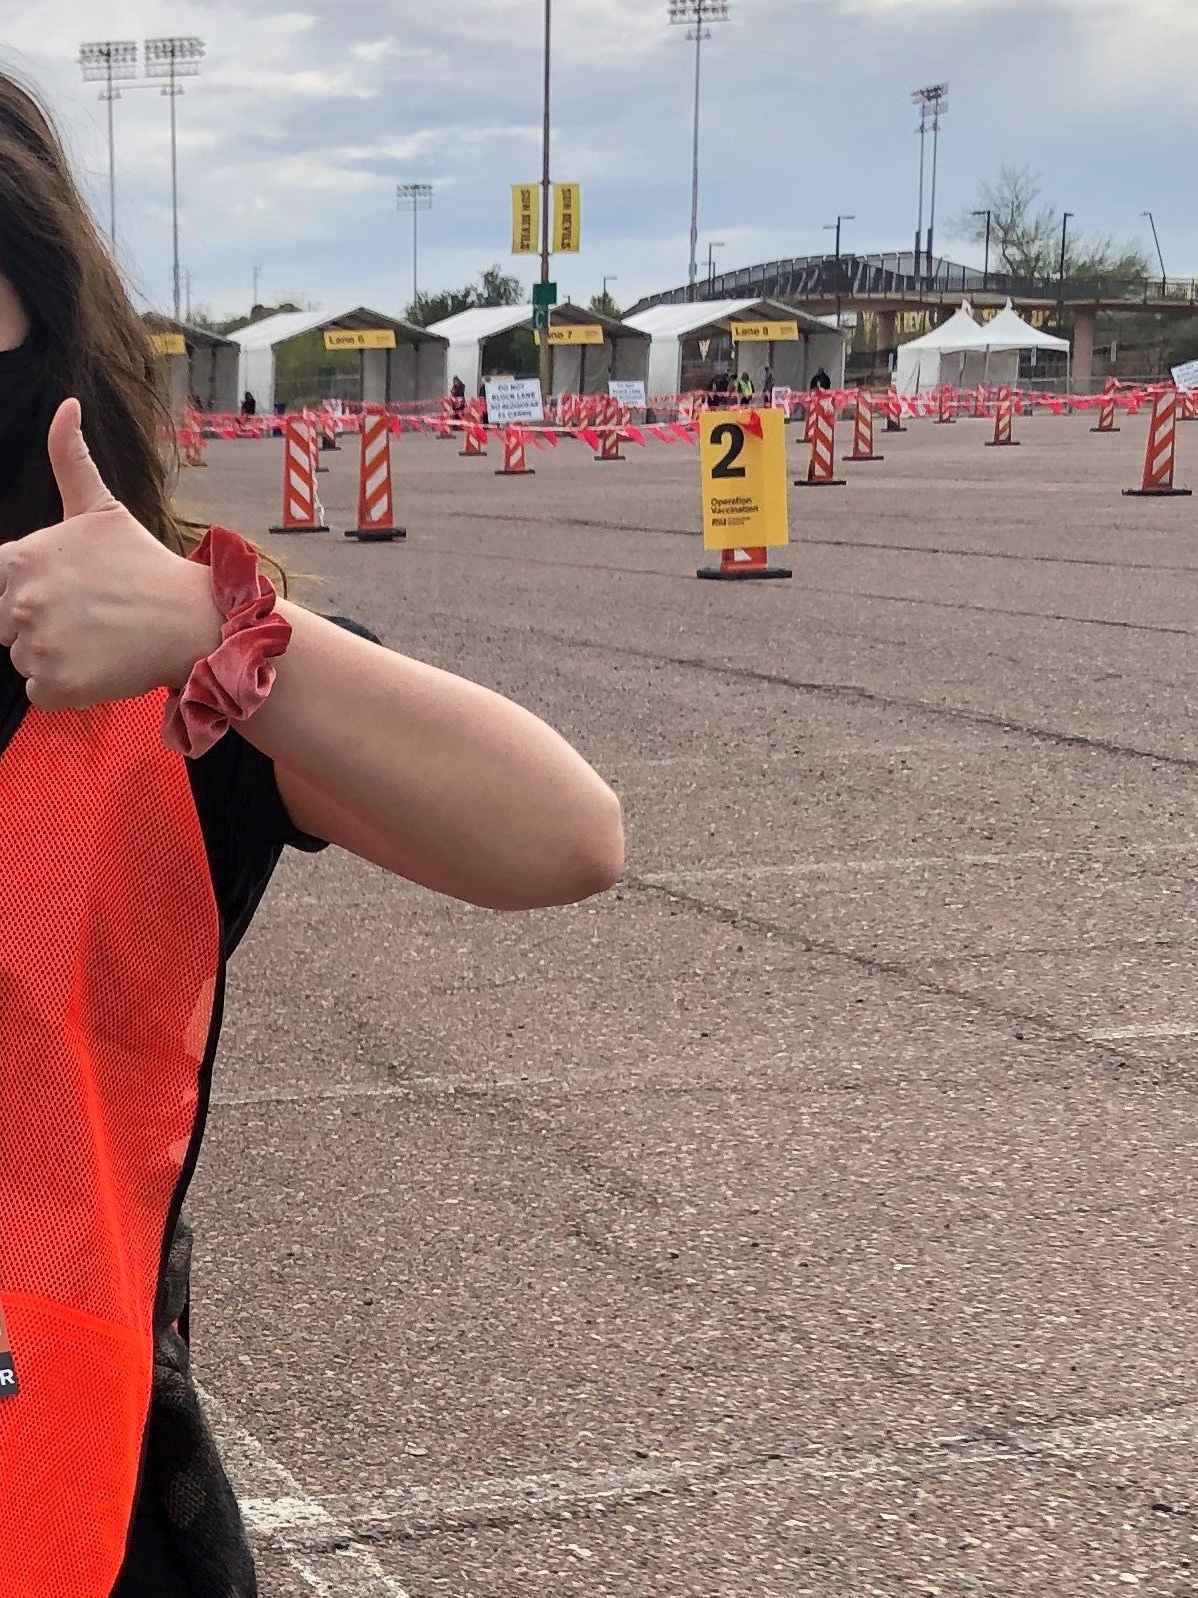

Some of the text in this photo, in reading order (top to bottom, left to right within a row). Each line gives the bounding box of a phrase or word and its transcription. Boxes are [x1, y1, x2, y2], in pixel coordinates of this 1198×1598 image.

[328, 334, 355, 345] Lane
[710, 423, 745, 478] 2
[711, 497, 752, 507] Operation
[711, 506, 758, 515] Vaccination
